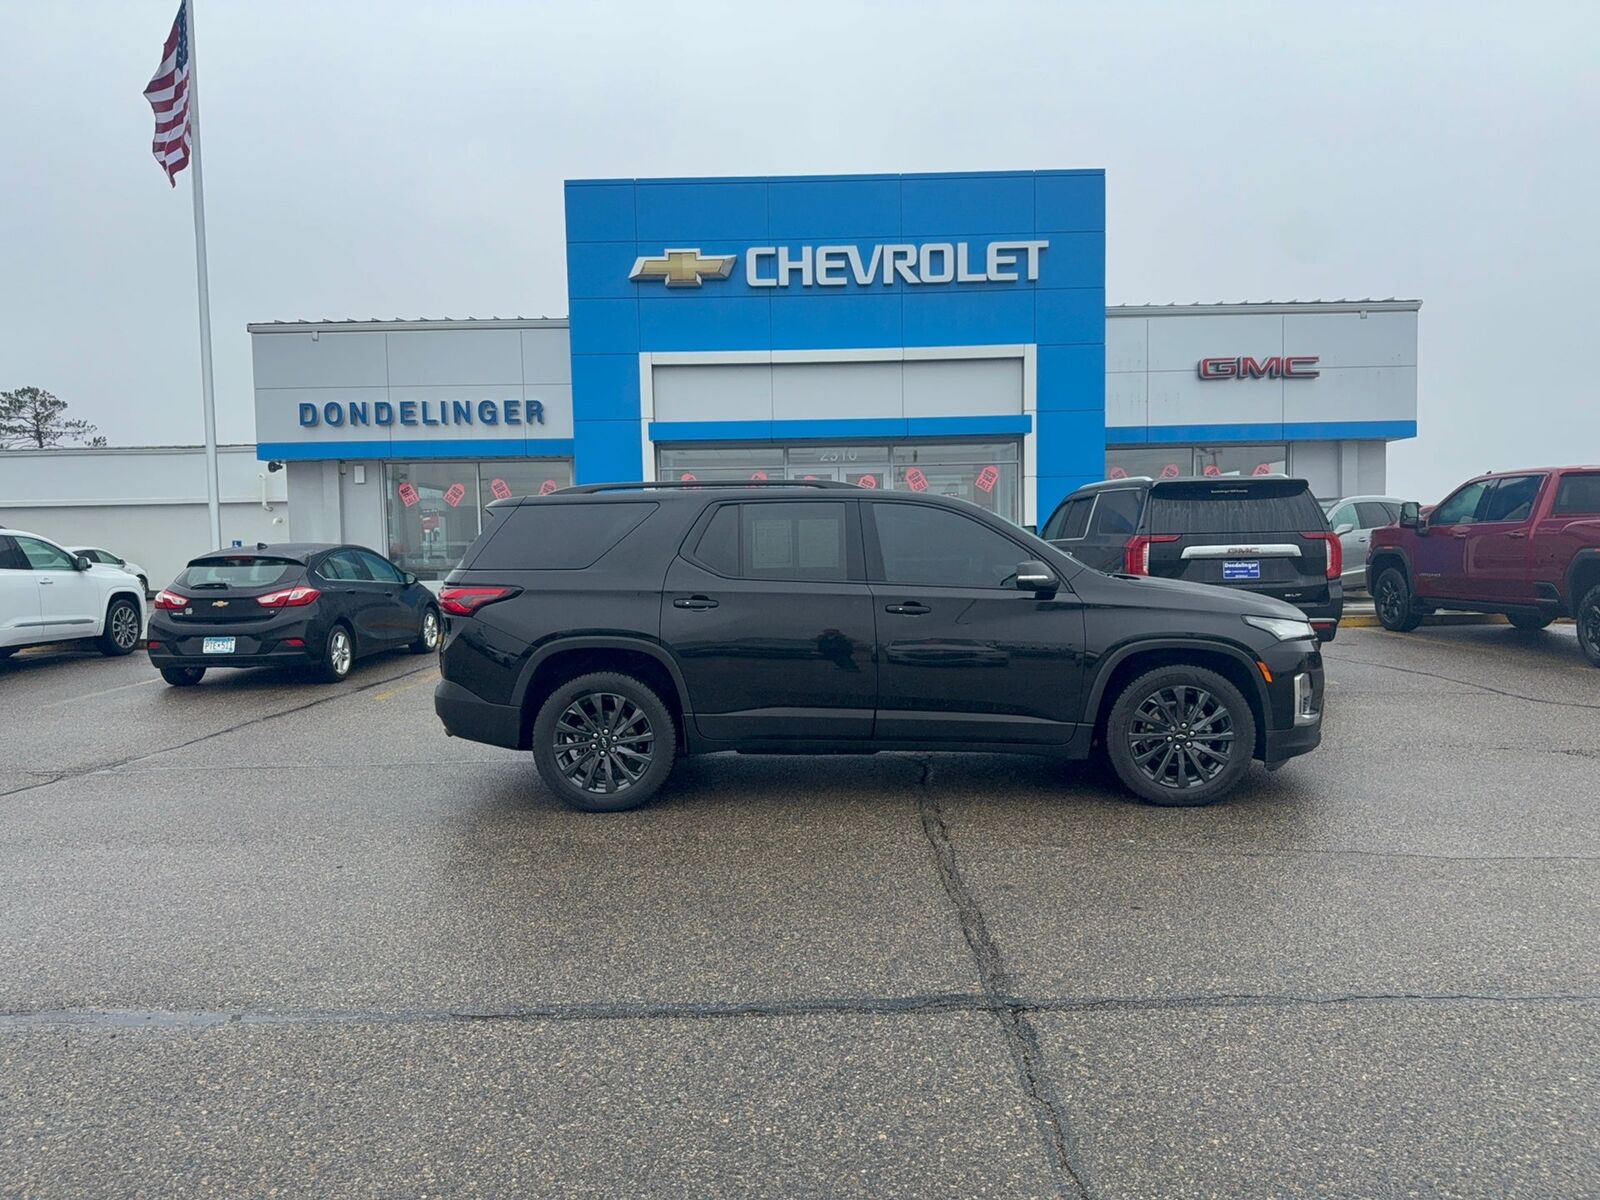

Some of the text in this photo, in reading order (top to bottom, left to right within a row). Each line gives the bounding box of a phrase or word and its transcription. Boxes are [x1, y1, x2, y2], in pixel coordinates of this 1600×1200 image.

[745, 240, 1049, 287] CHEVROLET
[1198, 356, 1320, 380] GMC
[299, 400, 546, 427] DONDELINGER
